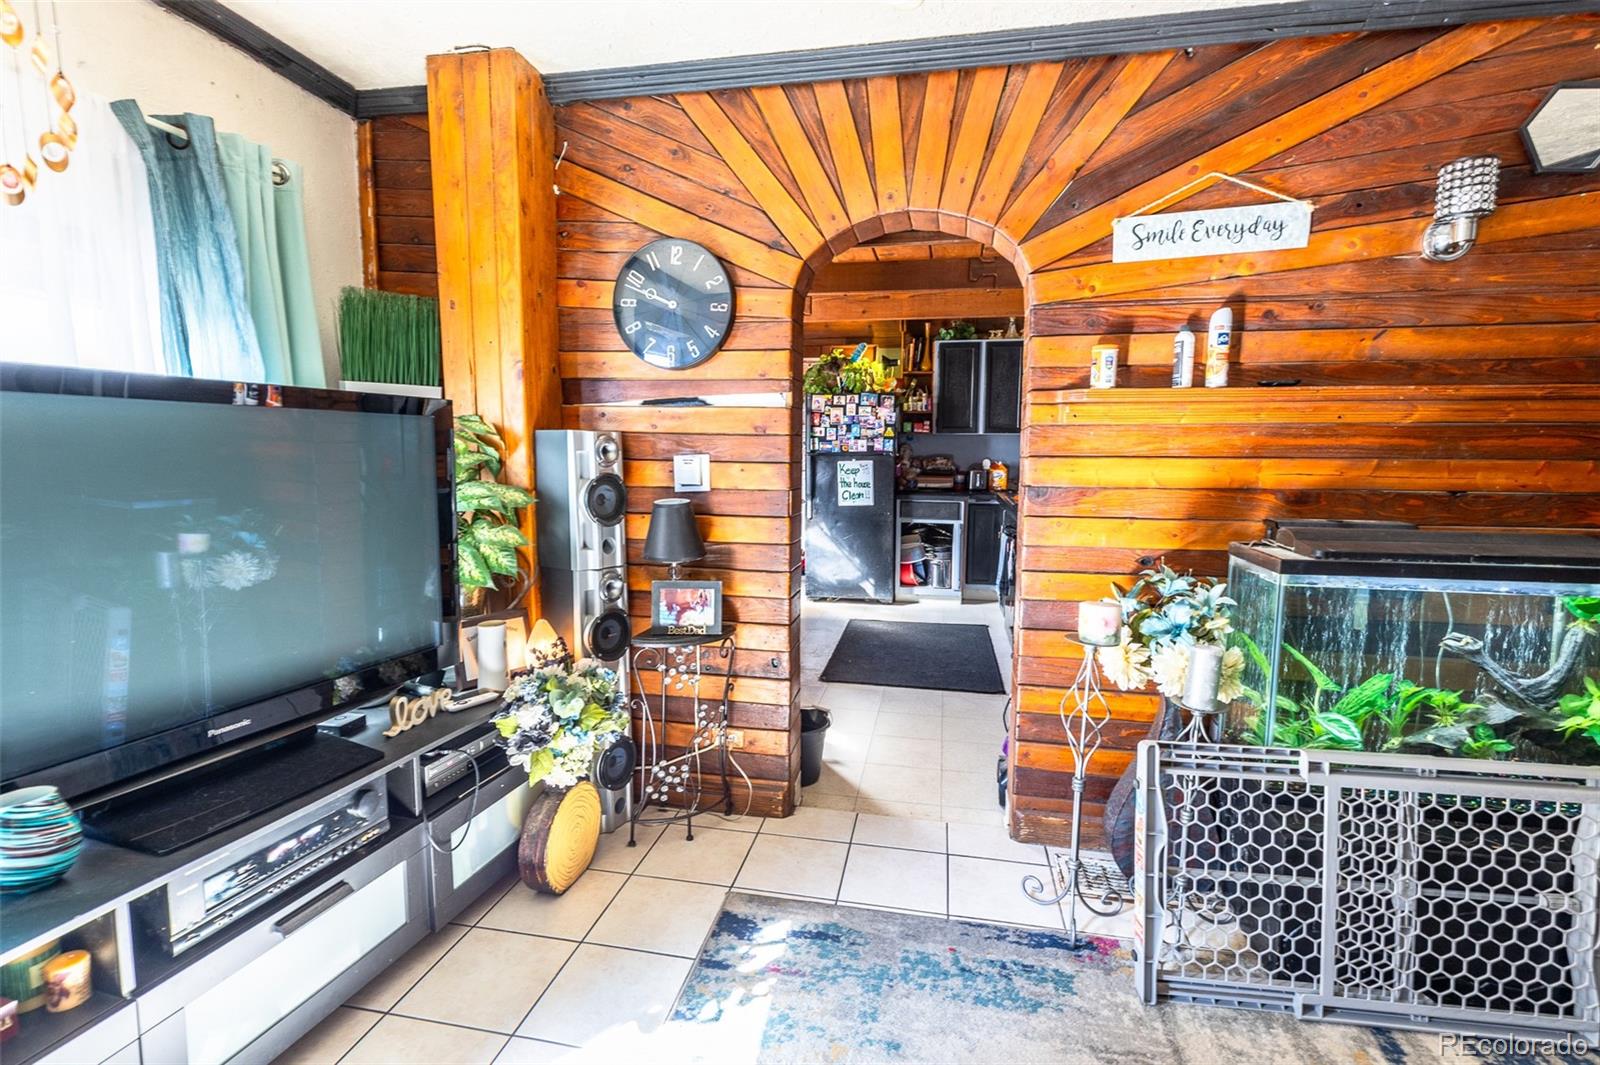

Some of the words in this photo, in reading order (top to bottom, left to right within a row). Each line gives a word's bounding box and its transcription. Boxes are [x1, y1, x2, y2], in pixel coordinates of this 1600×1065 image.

[1131, 219, 1186, 251] Smile
[1190, 215, 1289, 245] Everyday
[646, 251, 661, 271] 11
[670, 245, 683, 265] 12
[693, 254, 705, 271] 1
[626, 270, 646, 288] 10
[705, 275, 724, 290] 2
[624, 320, 642, 335] 8
[704, 324, 721, 339] 4
[643, 337, 657, 354] 7
[686, 339, 700, 358] 5
[839, 463, 860, 477] Keep
[382, 688, 453, 738] love
[207, 719, 252, 738] Panasonic
